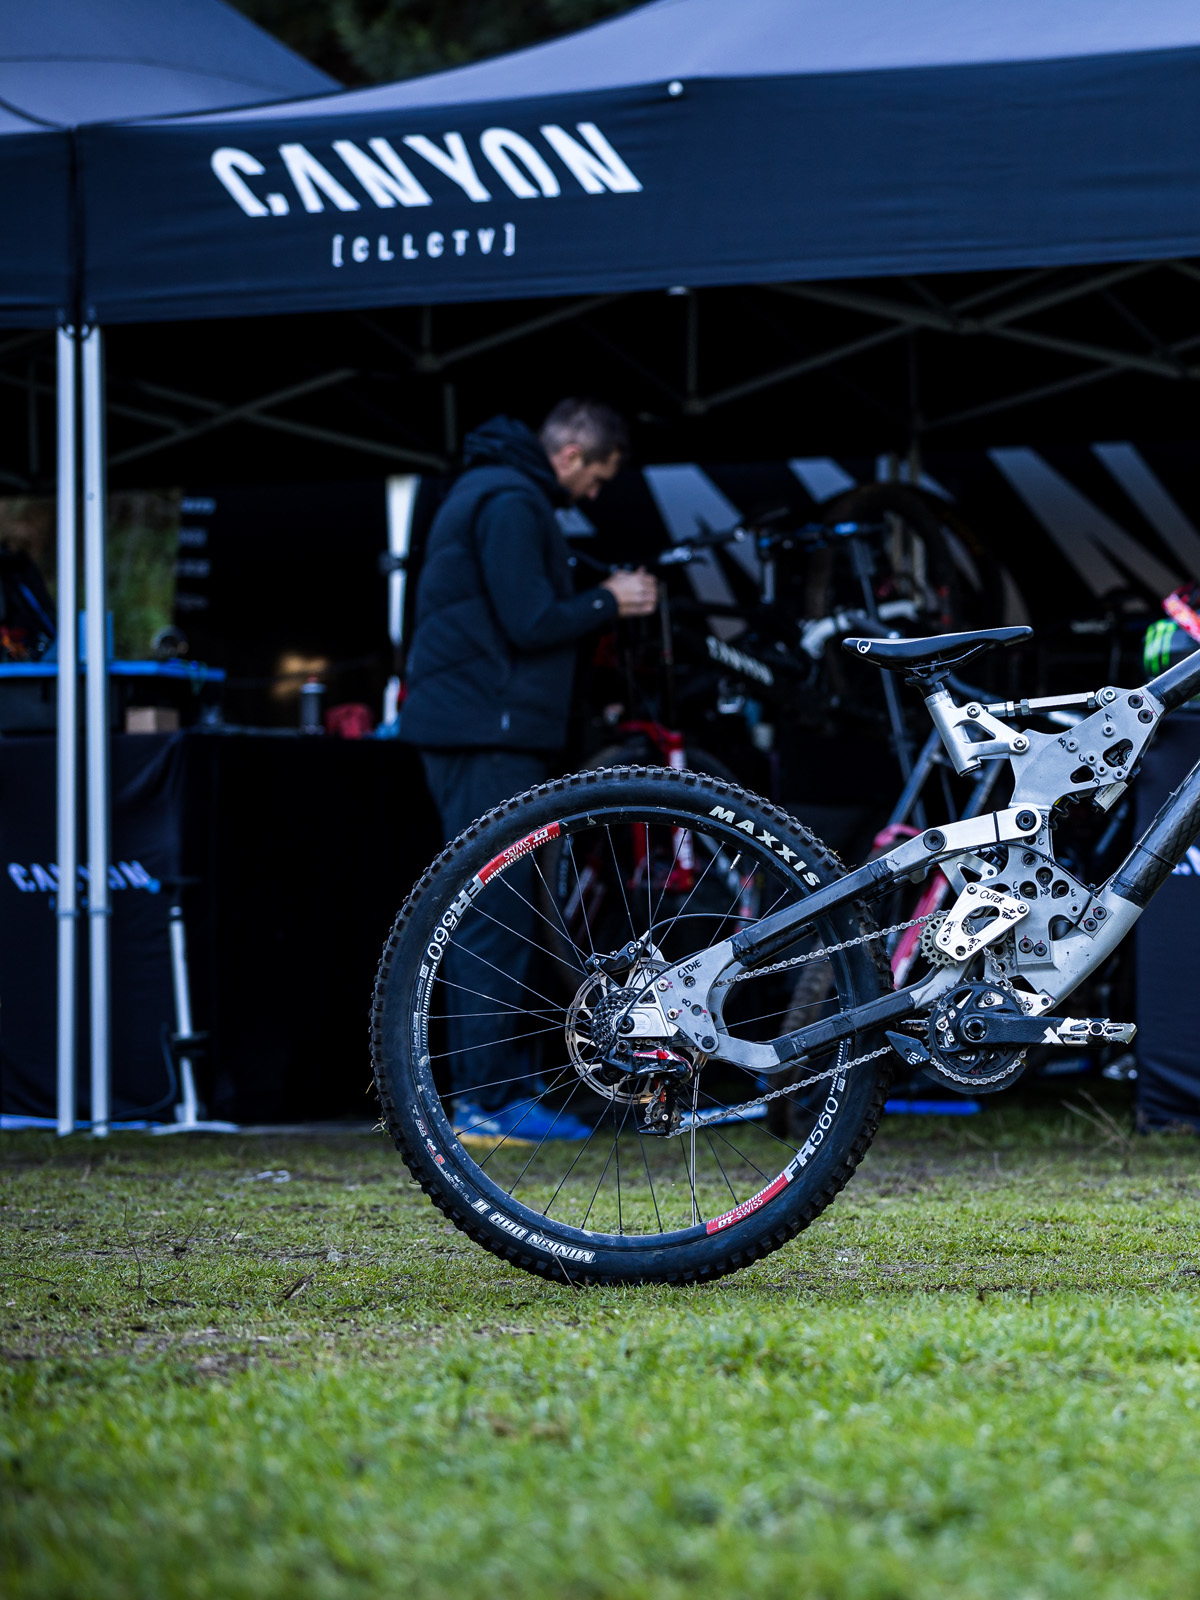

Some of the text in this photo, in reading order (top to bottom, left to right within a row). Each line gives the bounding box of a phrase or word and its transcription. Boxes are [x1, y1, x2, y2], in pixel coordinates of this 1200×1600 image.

[211, 122, 643, 217] CANYON
[708, 805, 821, 886] MAXXIS
[427, 828, 549, 960] DT SWISS FR560
[736, 1197, 764, 1220] SWISS
[784, 1096, 839, 1182] FR560
[488, 1211, 529, 1240] DHR
[526, 1232, 596, 1264] MINION
